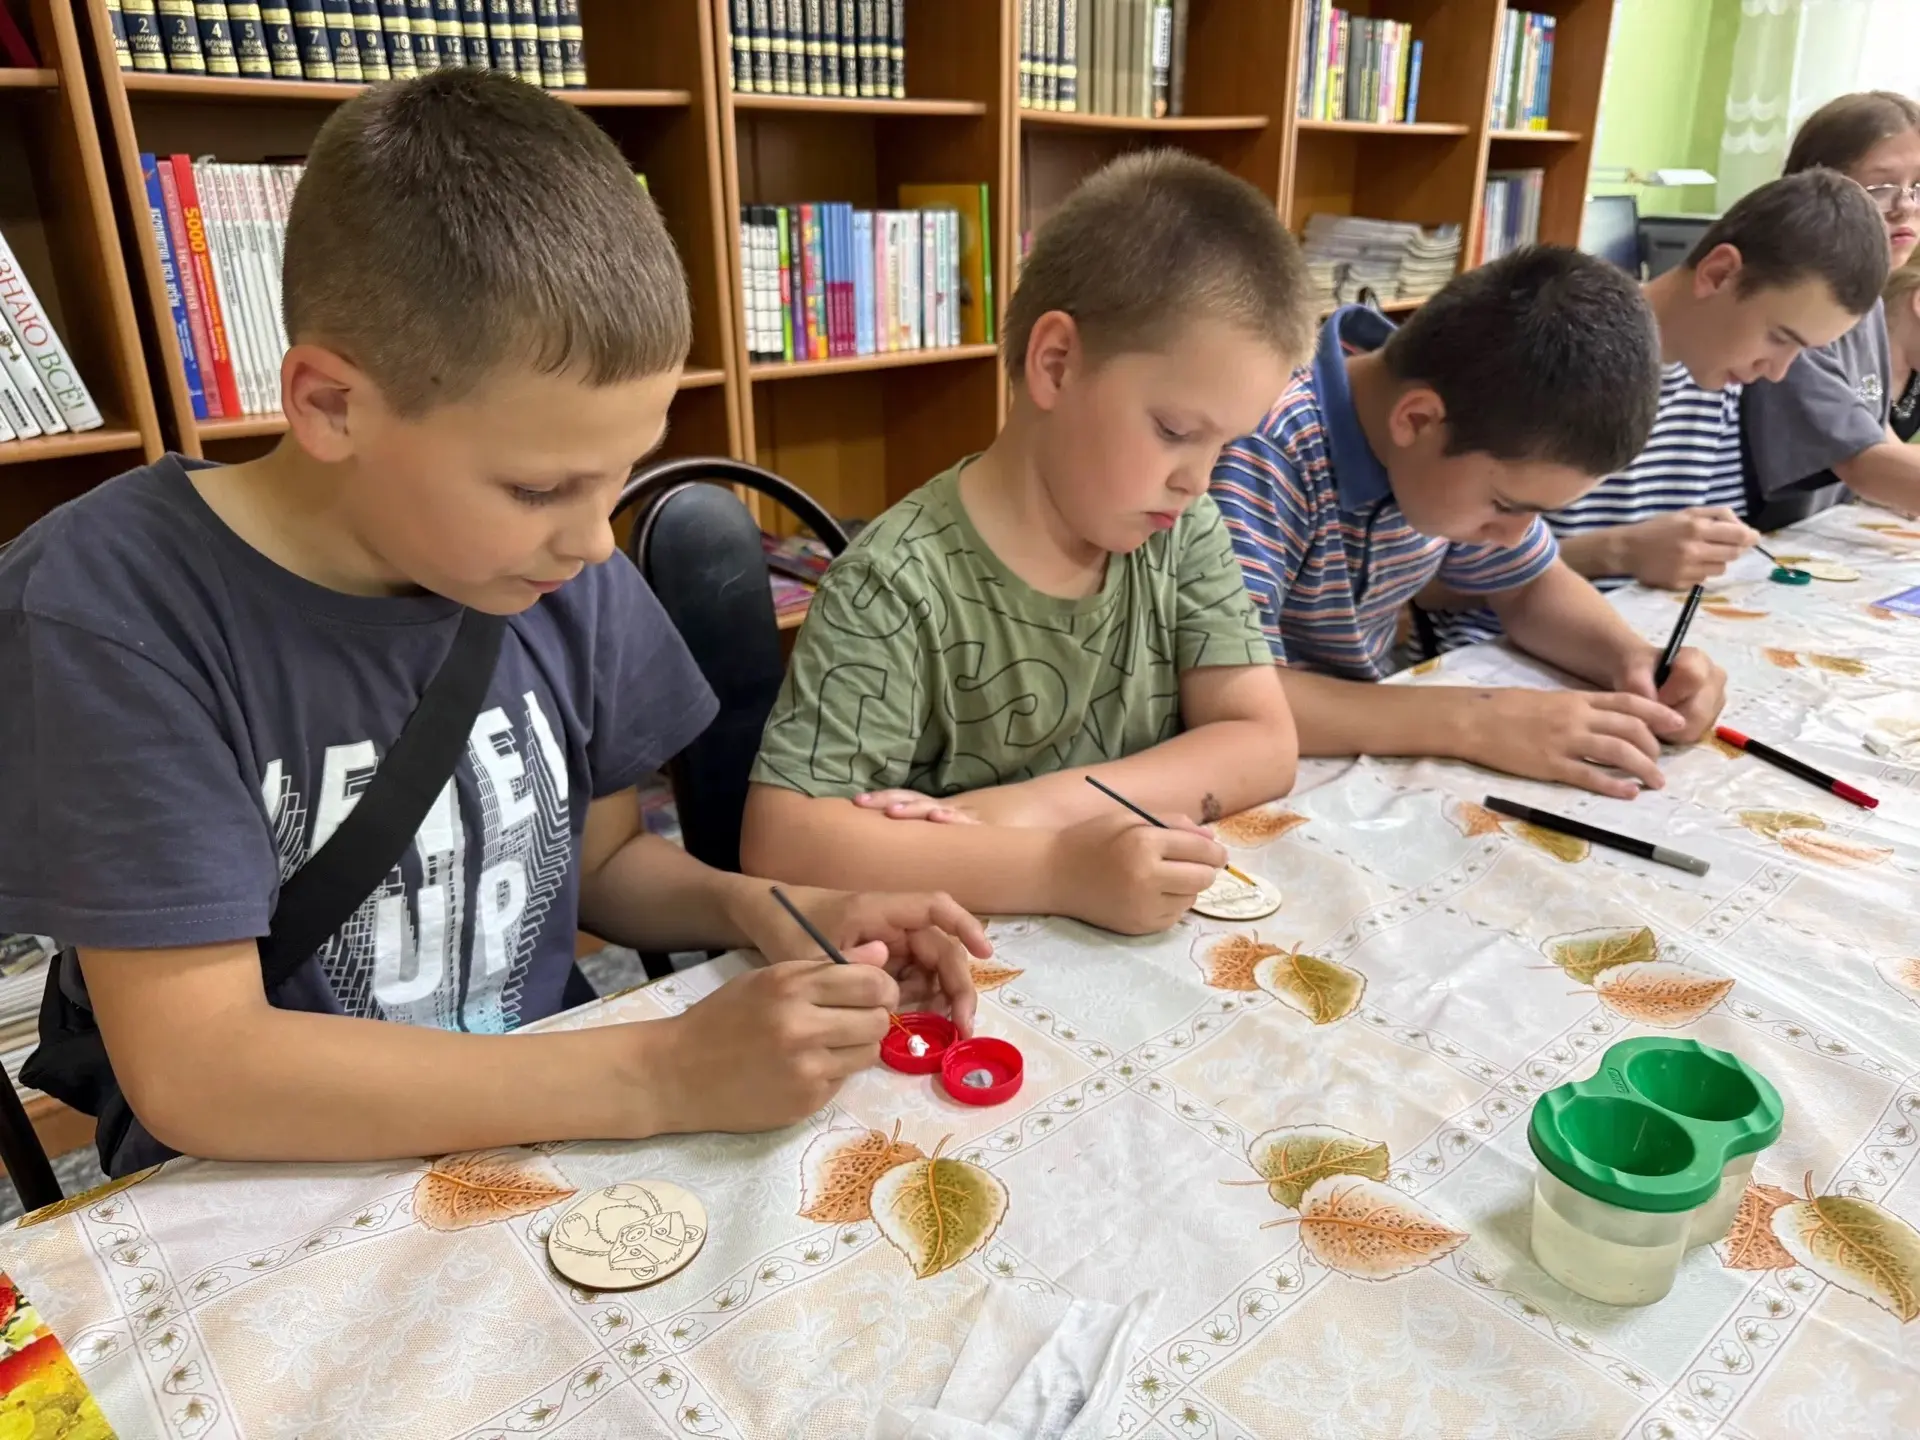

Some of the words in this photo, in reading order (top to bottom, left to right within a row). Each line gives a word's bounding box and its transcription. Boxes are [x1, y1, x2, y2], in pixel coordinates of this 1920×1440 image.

[138, 17, 150, 33] 2
[177, 19, 187, 34] 3
[211, 22, 222, 38] 4
[244, 23, 255, 38] 5
[277, 27, 288, 42] 6
[309, 29, 319, 44] 7
[340, 31, 350, 46] 8
[366, 32, 377, 47] 9
[393, 33, 410, 50] 10
[419, 35, 435, 51] 11
[445, 37, 461, 53] 12
[473, 39, 488, 55] 13
[499, 41, 513, 55] 14
[522, 41, 536, 55] 15
[546, 43, 561, 58] 16
[567, 42, 581, 56] 17
[184, 206, 206, 254] 5000
[374, 860, 527, 1005] UP
